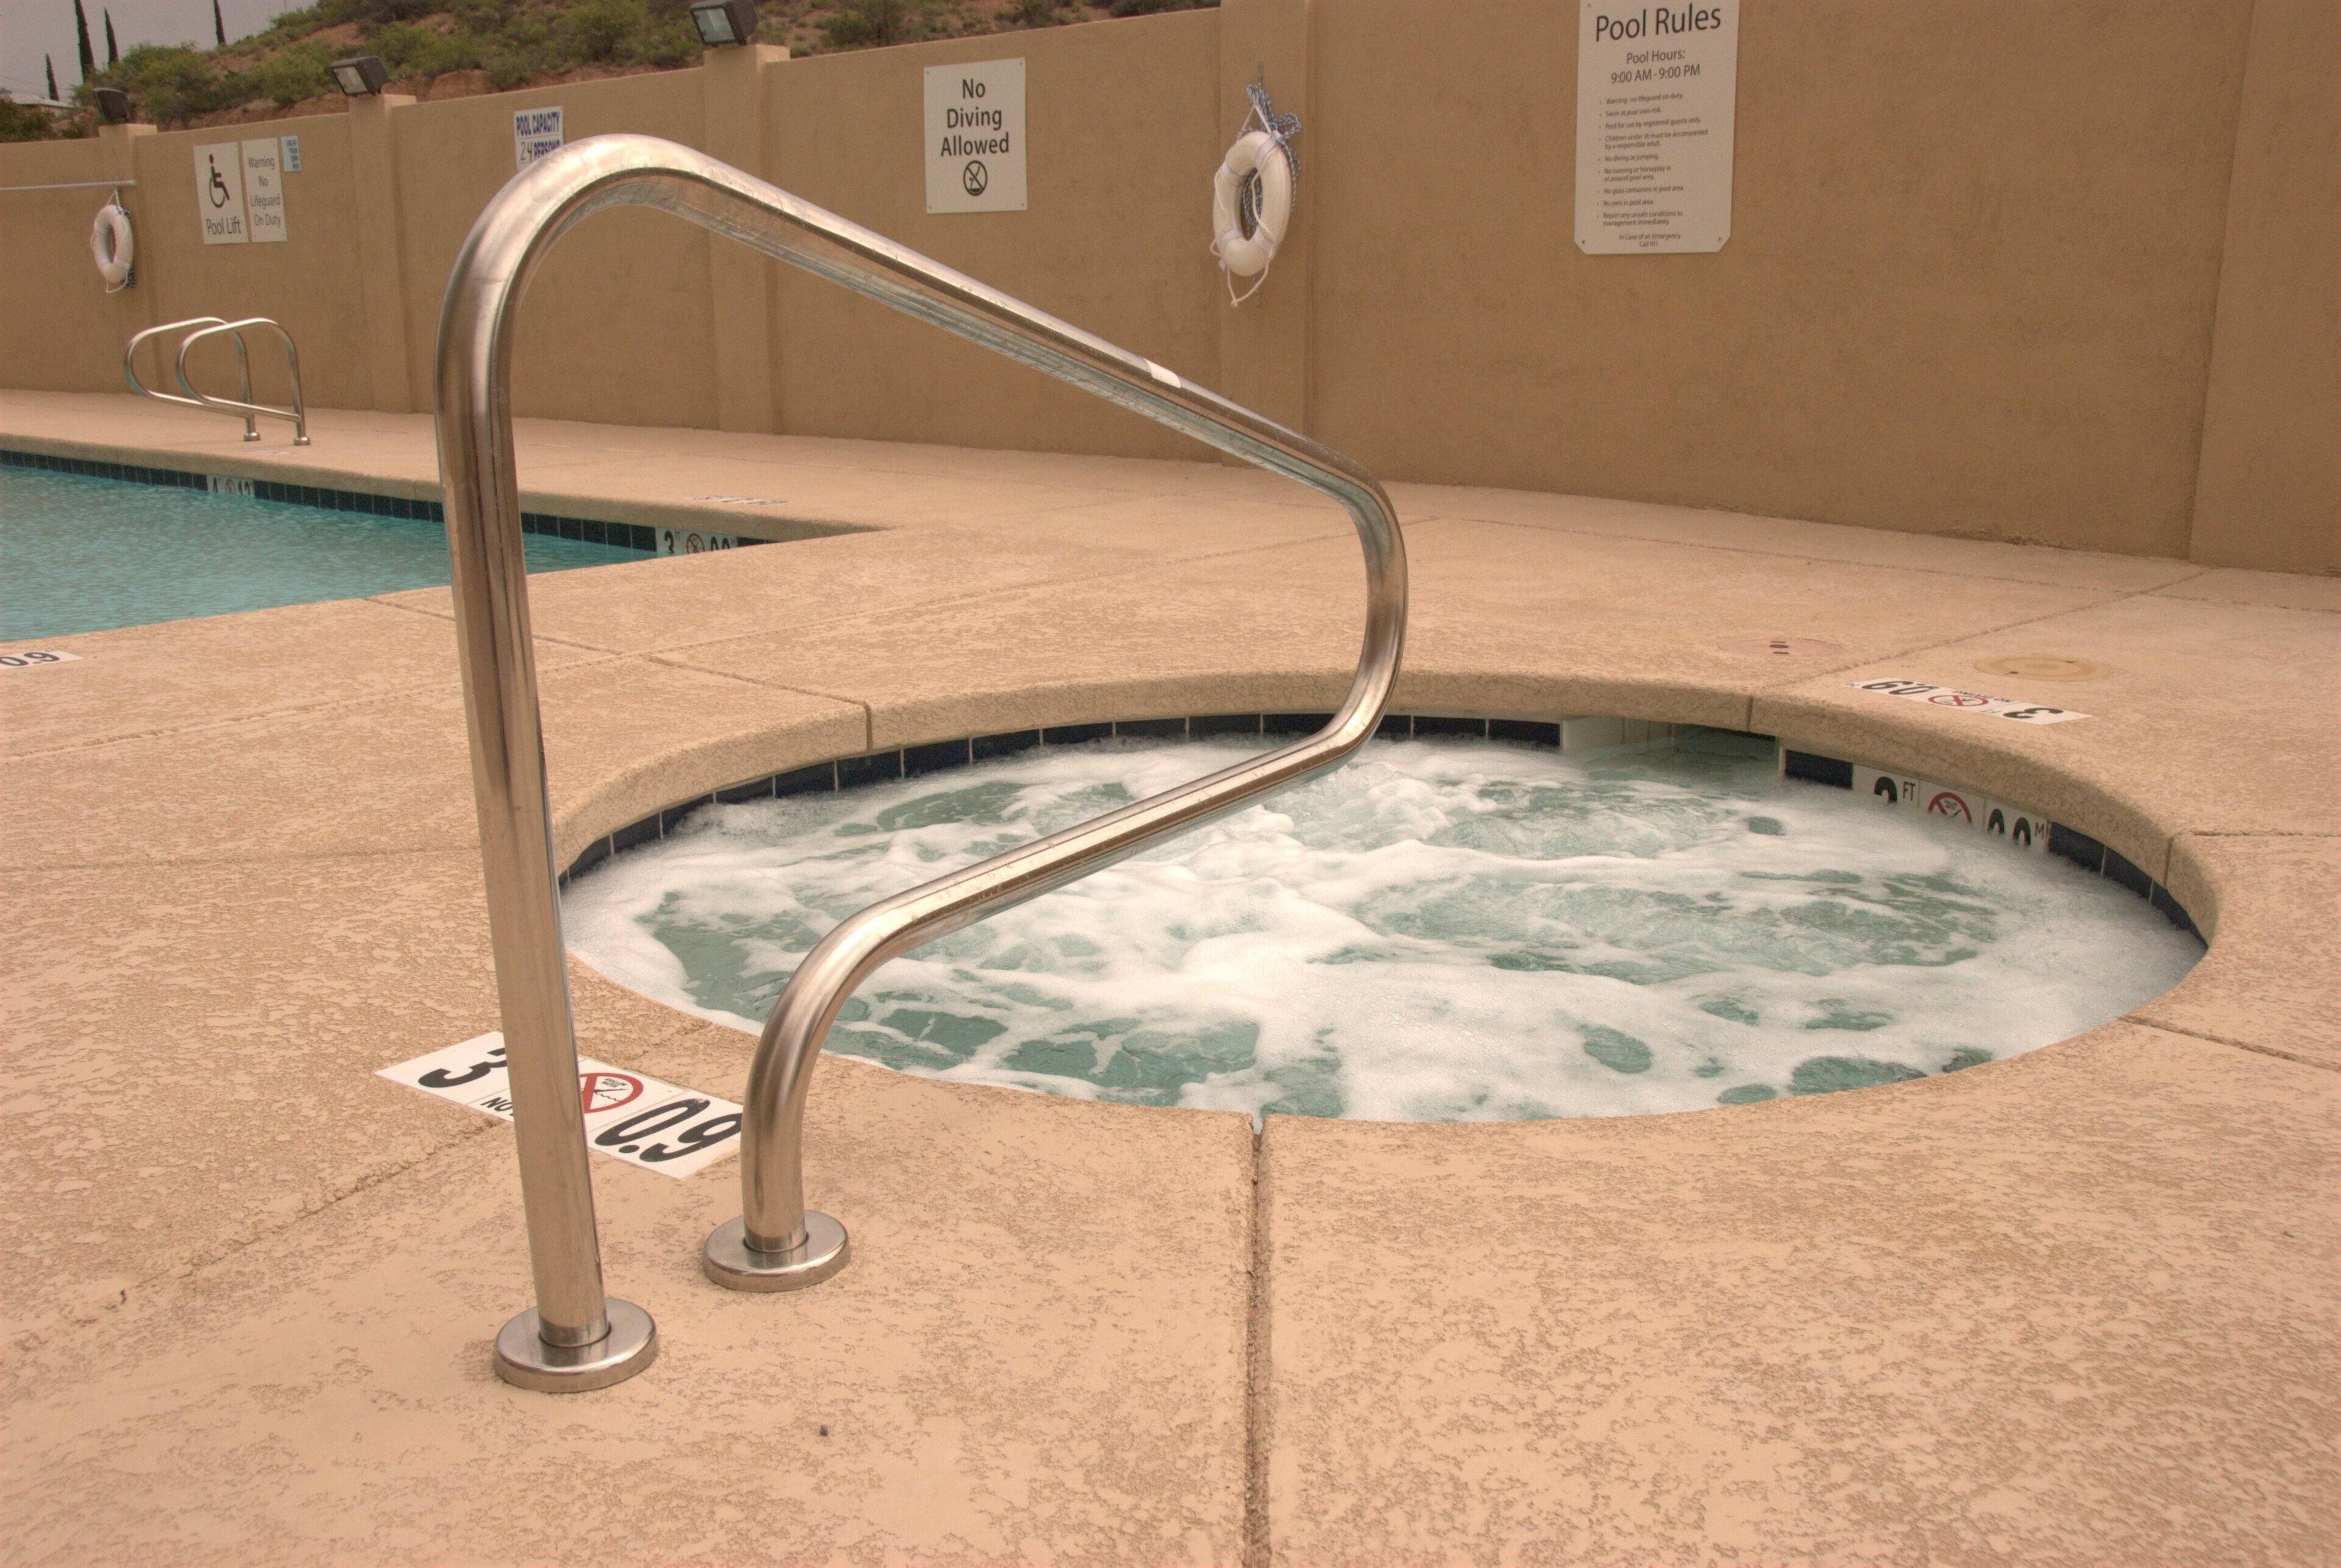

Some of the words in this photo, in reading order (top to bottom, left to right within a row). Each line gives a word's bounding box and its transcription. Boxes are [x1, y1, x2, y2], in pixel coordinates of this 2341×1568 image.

[1596, 9, 1646, 41] Pool
[1655, 3, 1720, 35] Rules
[1627, 51, 1648, 64] Pool
[1652, 49, 1685, 61] Hours:
[1611, 71, 1632, 84] 9:00
[1634, 69, 1652, 82] AM
[1659, 66, 1681, 79] 9:00
[1684, 64, 1700, 77] PM
[963, 78, 985, 99] No
[1638, 94, 1661, 102] lifeguard
[516, 115, 532, 137] POOL
[532, 111, 560, 134] CAPACITY
[947, 106, 1002, 130] Diving
[1672, 129, 1708, 137] accompanied
[521, 141, 533, 162] 24
[941, 132, 1009, 157] Allowed
[248, 157, 275, 170] Warning
[258, 176, 268, 187] No
[251, 194, 280, 209] Lifeguard
[206, 218, 225, 235] Pool
[226, 216, 241, 234] Lift
[254, 215, 264, 226] On
[265, 214, 281, 228] Duty
[2003, 707, 2064, 719] 3
[1903, 781, 1915, 801] FT
[2034, 821, 2045, 839] M
[418, 1047, 508, 1088] 3
[594, 1097, 743, 1163] 0.9
